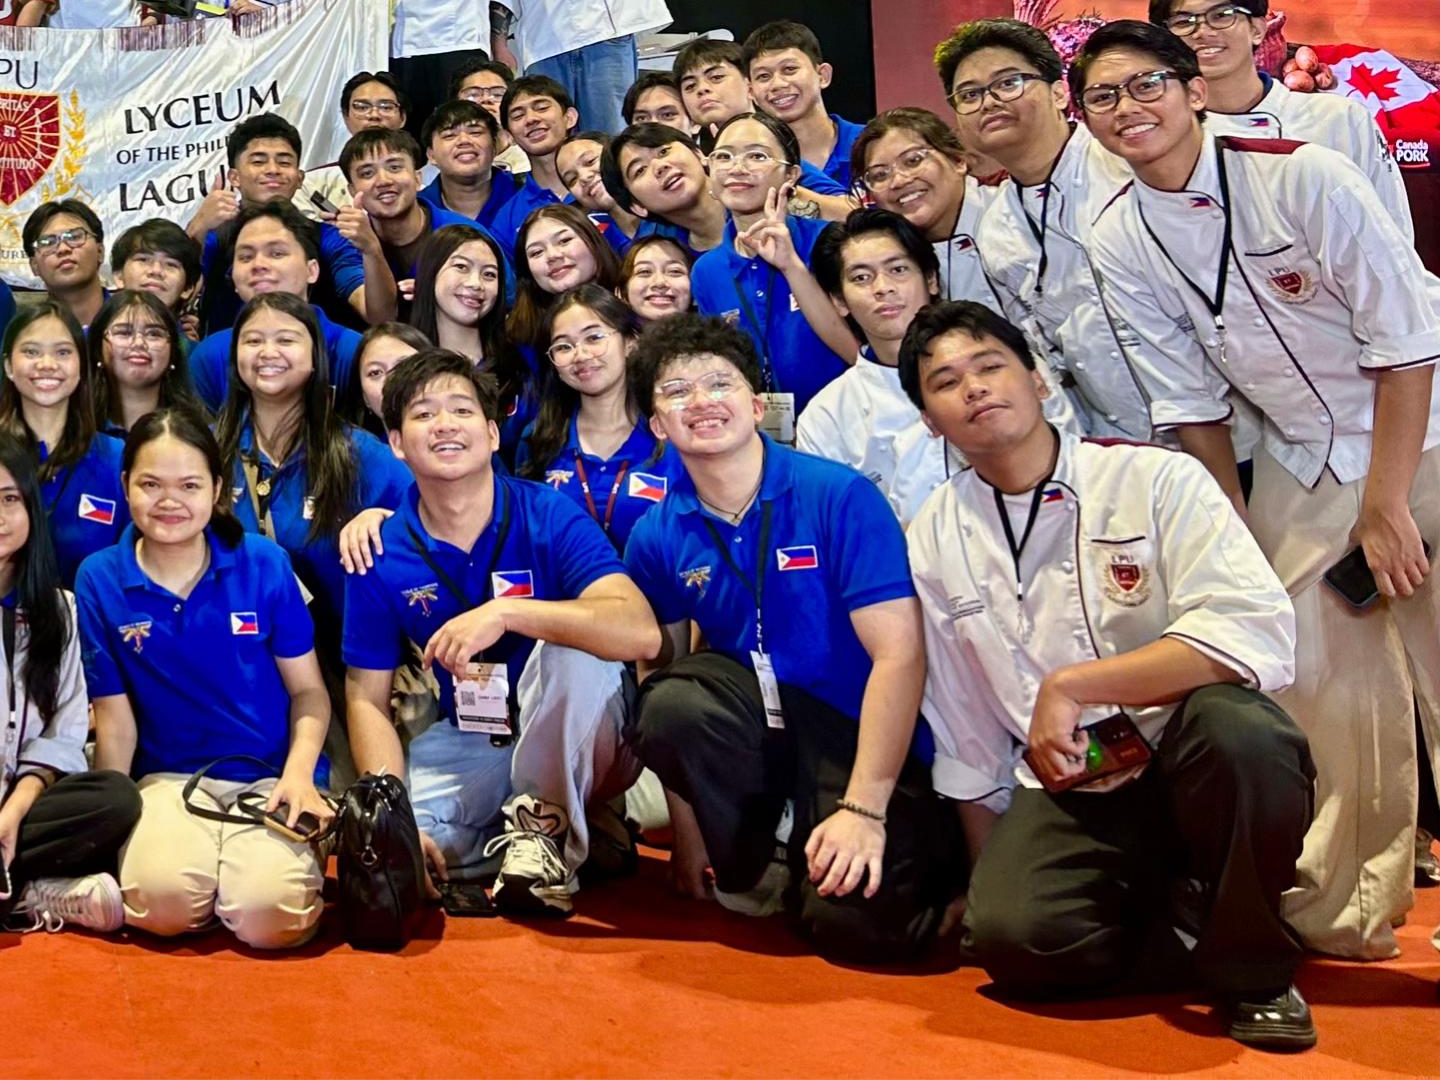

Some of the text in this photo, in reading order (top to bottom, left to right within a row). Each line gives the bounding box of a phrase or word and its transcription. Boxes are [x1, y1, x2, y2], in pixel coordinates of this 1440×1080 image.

[124, 80, 280, 135] LYCEUM
[1396, 139, 1428, 150] Canada
[116, 145, 180, 164] OF THE
[1396, 150, 1429, 162] PORK
